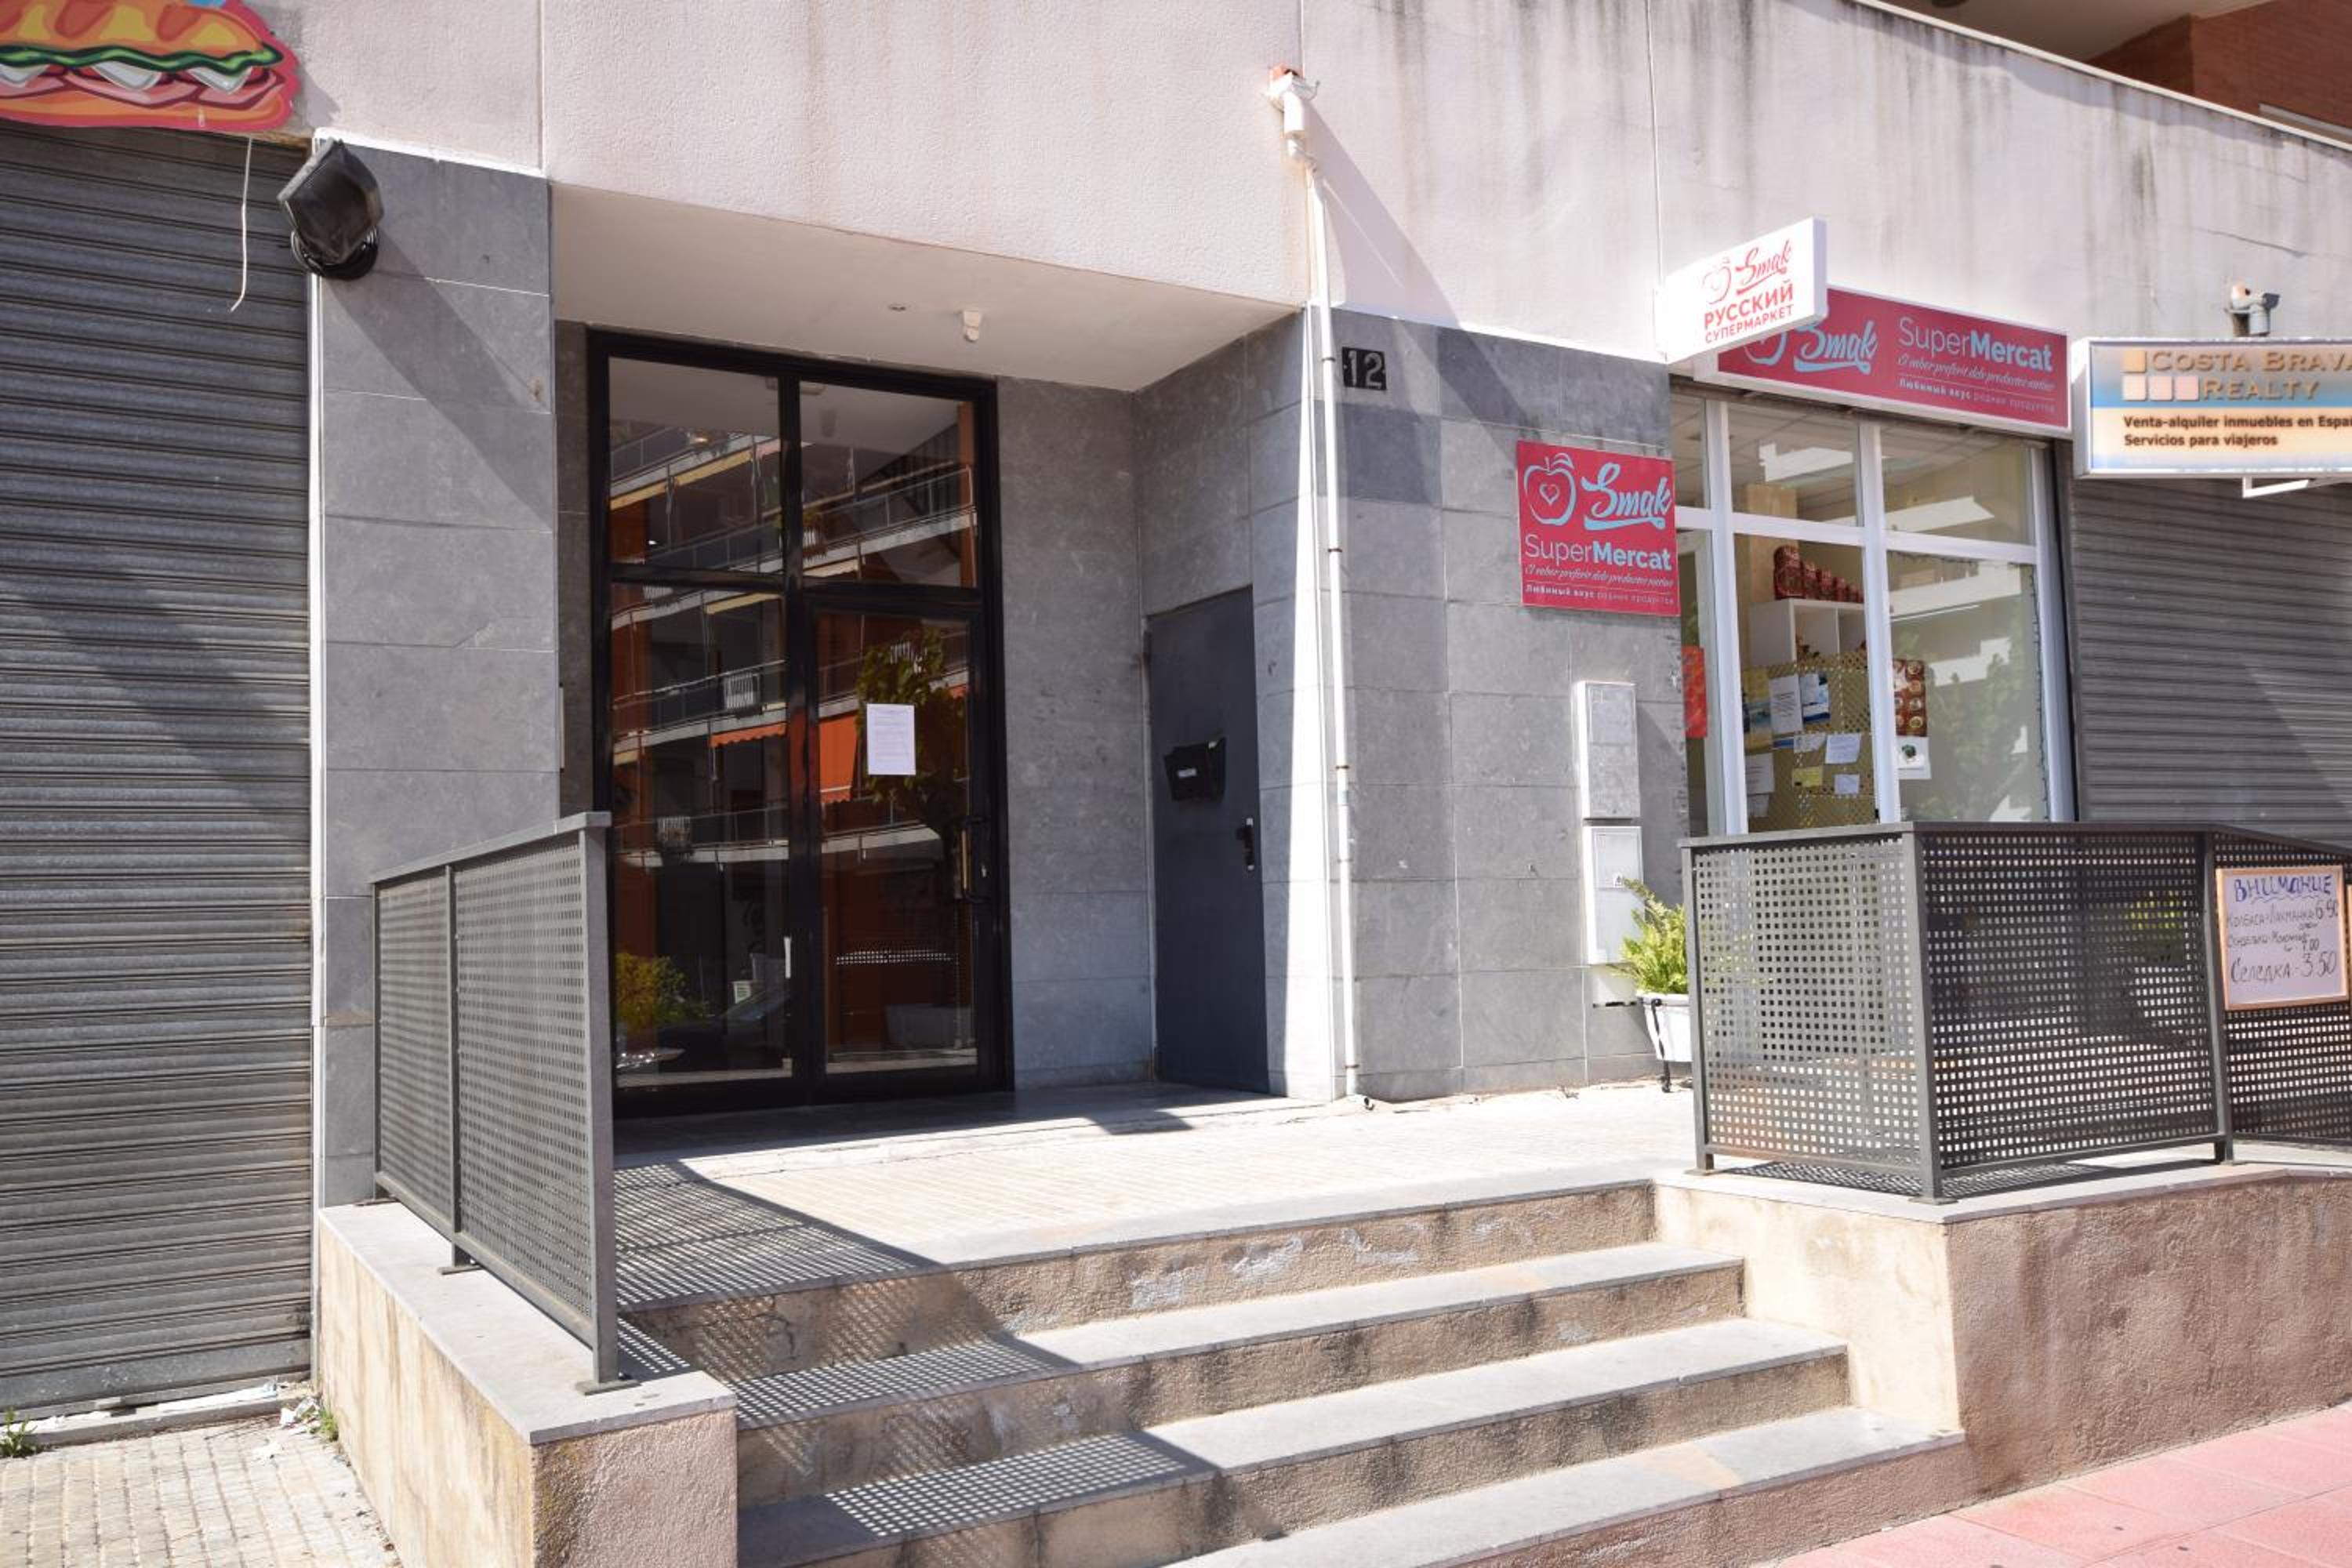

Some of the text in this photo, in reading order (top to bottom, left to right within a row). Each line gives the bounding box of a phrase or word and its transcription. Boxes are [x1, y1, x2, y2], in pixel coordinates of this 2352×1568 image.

[1735, 238, 1791, 295] Smak
[1704, 279, 1794, 330] РУССКИЙ
[1705, 304, 1794, 344] СУПЕРМАРКЕТ
[1898, 316, 2053, 372] SuperMercat
[2152, 351, 2250, 372] COSTA
[1348, 350, 1382, 389] 12
[2204, 379, 2320, 401] REALTY
[2124, 416, 2352, 430] Venta-alquiler inmuebles en Espa
[2124, 434, 2278, 448] Servicios para viajeros
[1581, 463, 1672, 530] Smak
[1525, 534, 1672, 571] SuperMercat
